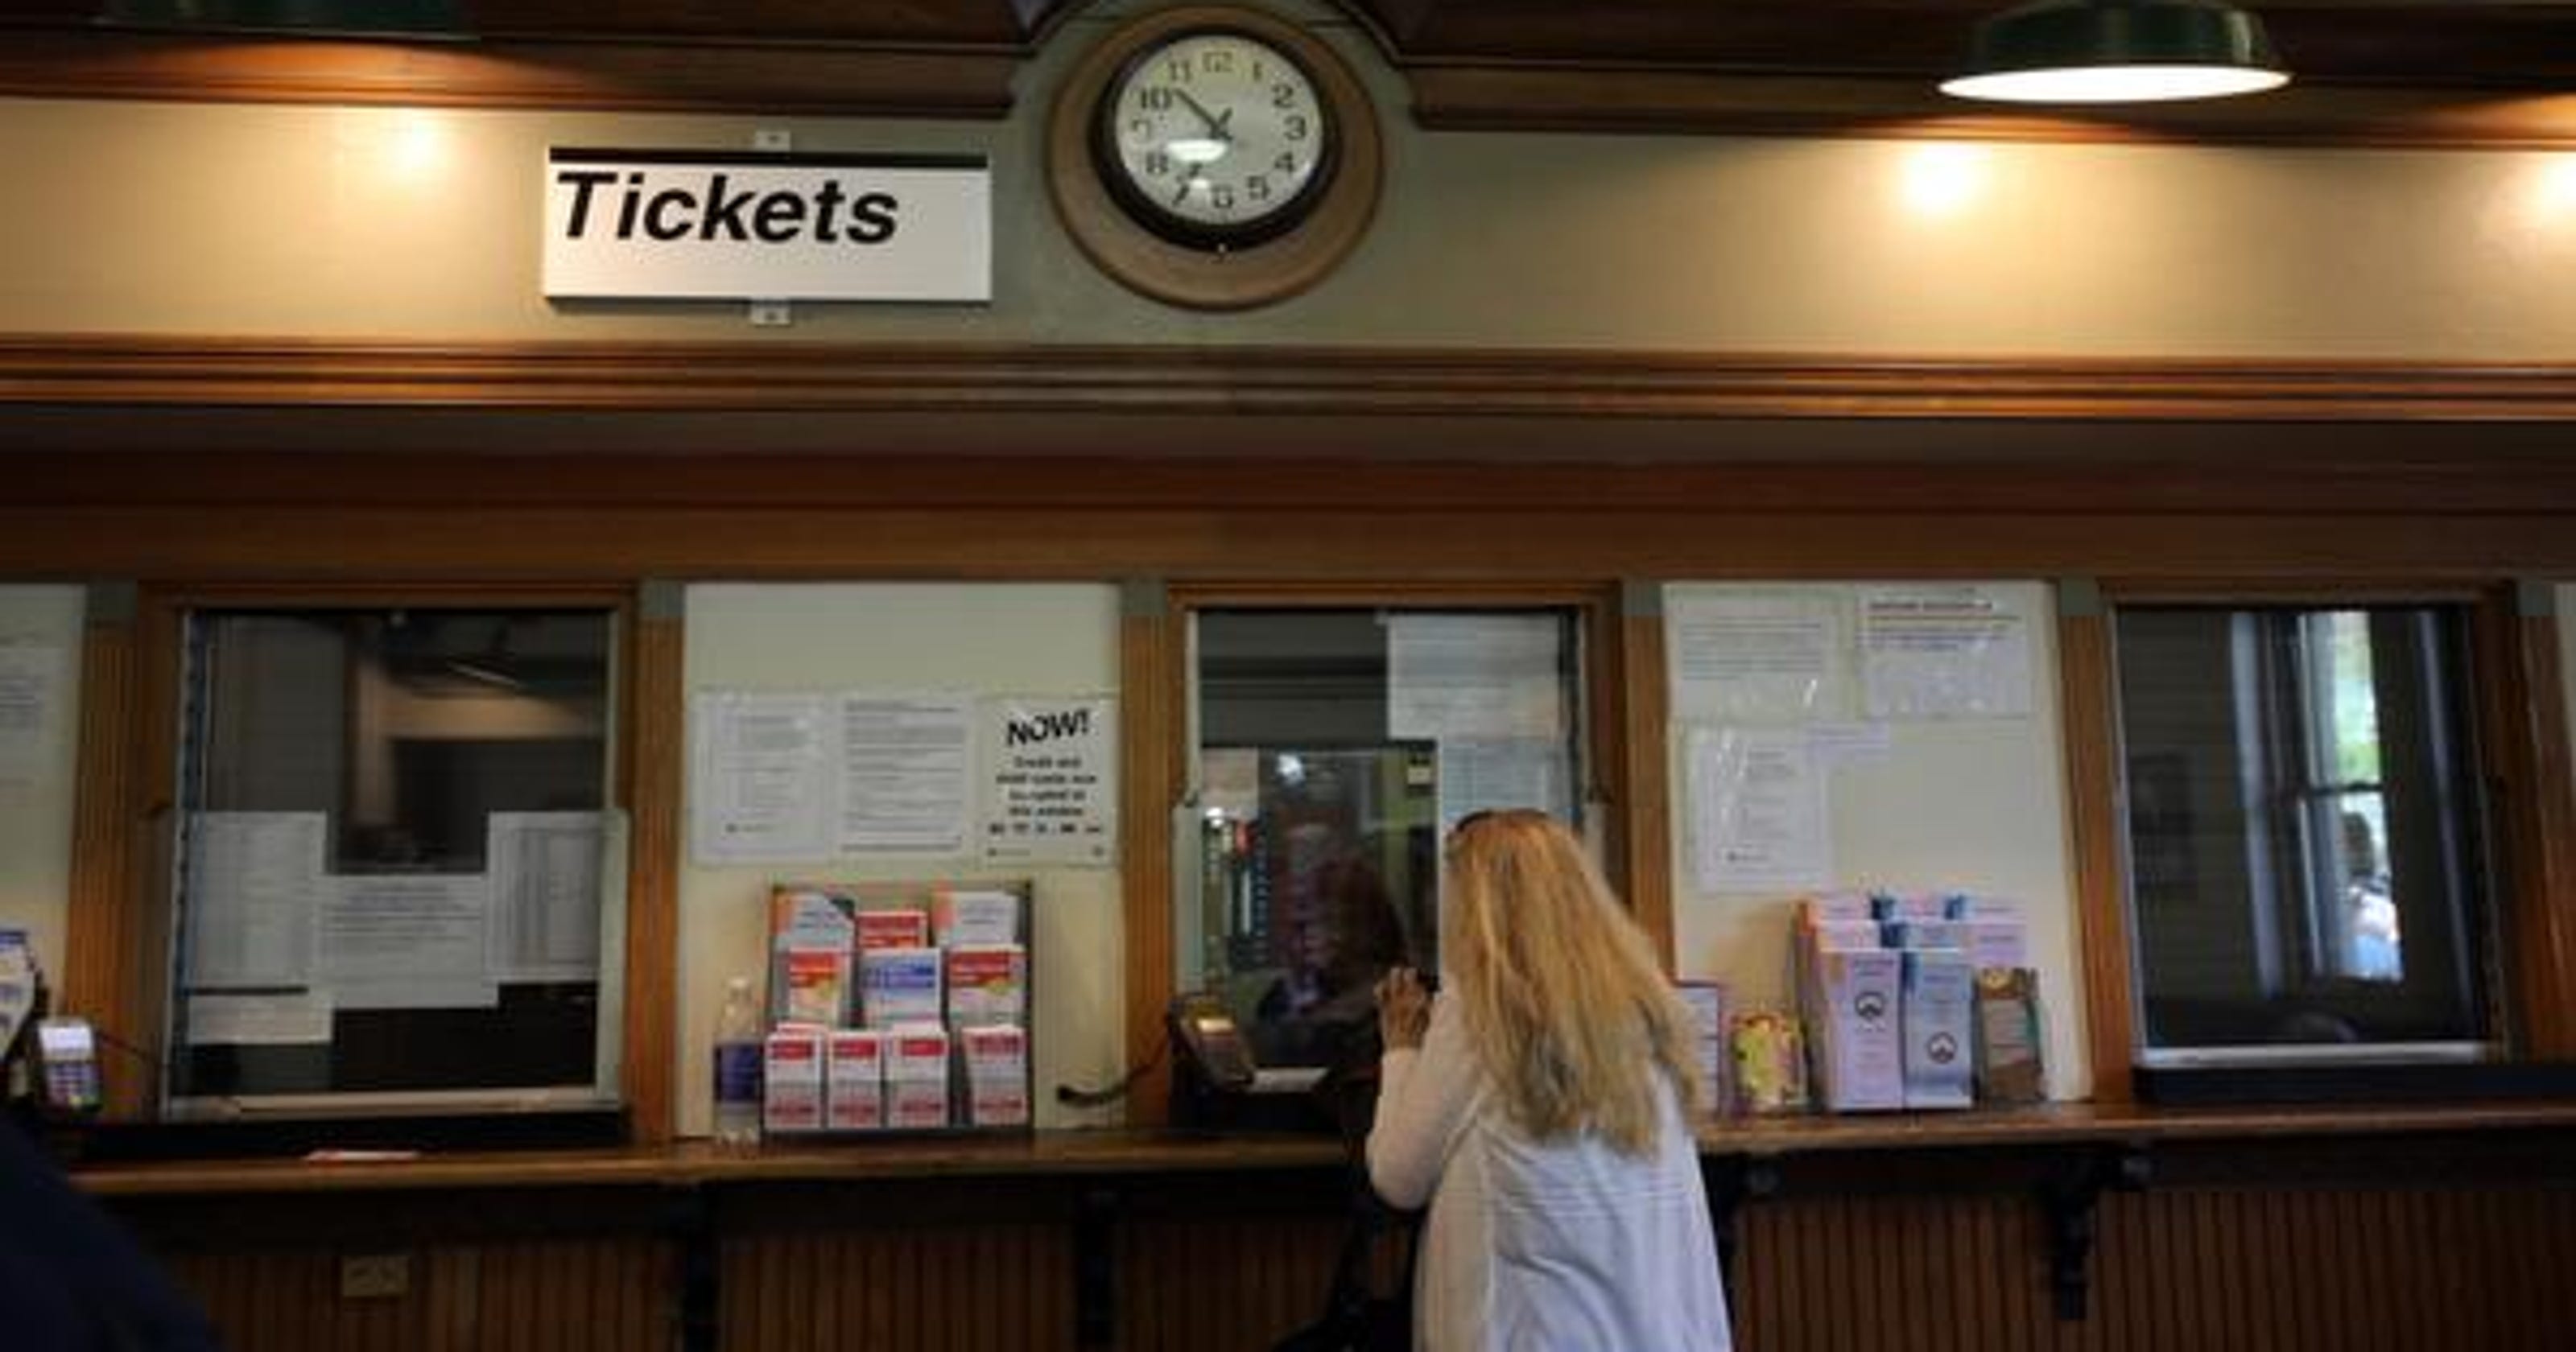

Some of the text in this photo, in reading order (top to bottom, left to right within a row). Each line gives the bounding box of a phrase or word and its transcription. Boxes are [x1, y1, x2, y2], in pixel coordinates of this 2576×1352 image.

[1169, 60, 1191, 82] 11
[1202, 52, 1233, 72] 12
[1251, 62, 1263, 81] 1
[1140, 88, 1172, 110] 10
[1273, 84, 1294, 108] 2
[1284, 116, 1307, 140] 3
[1275, 151, 1294, 172] 4
[1212, 184, 1234, 208] 6
[1247, 175, 1269, 200] 5
[556, 171, 899, 243] Tickets
[1007, 708, 1090, 746] NOW!
